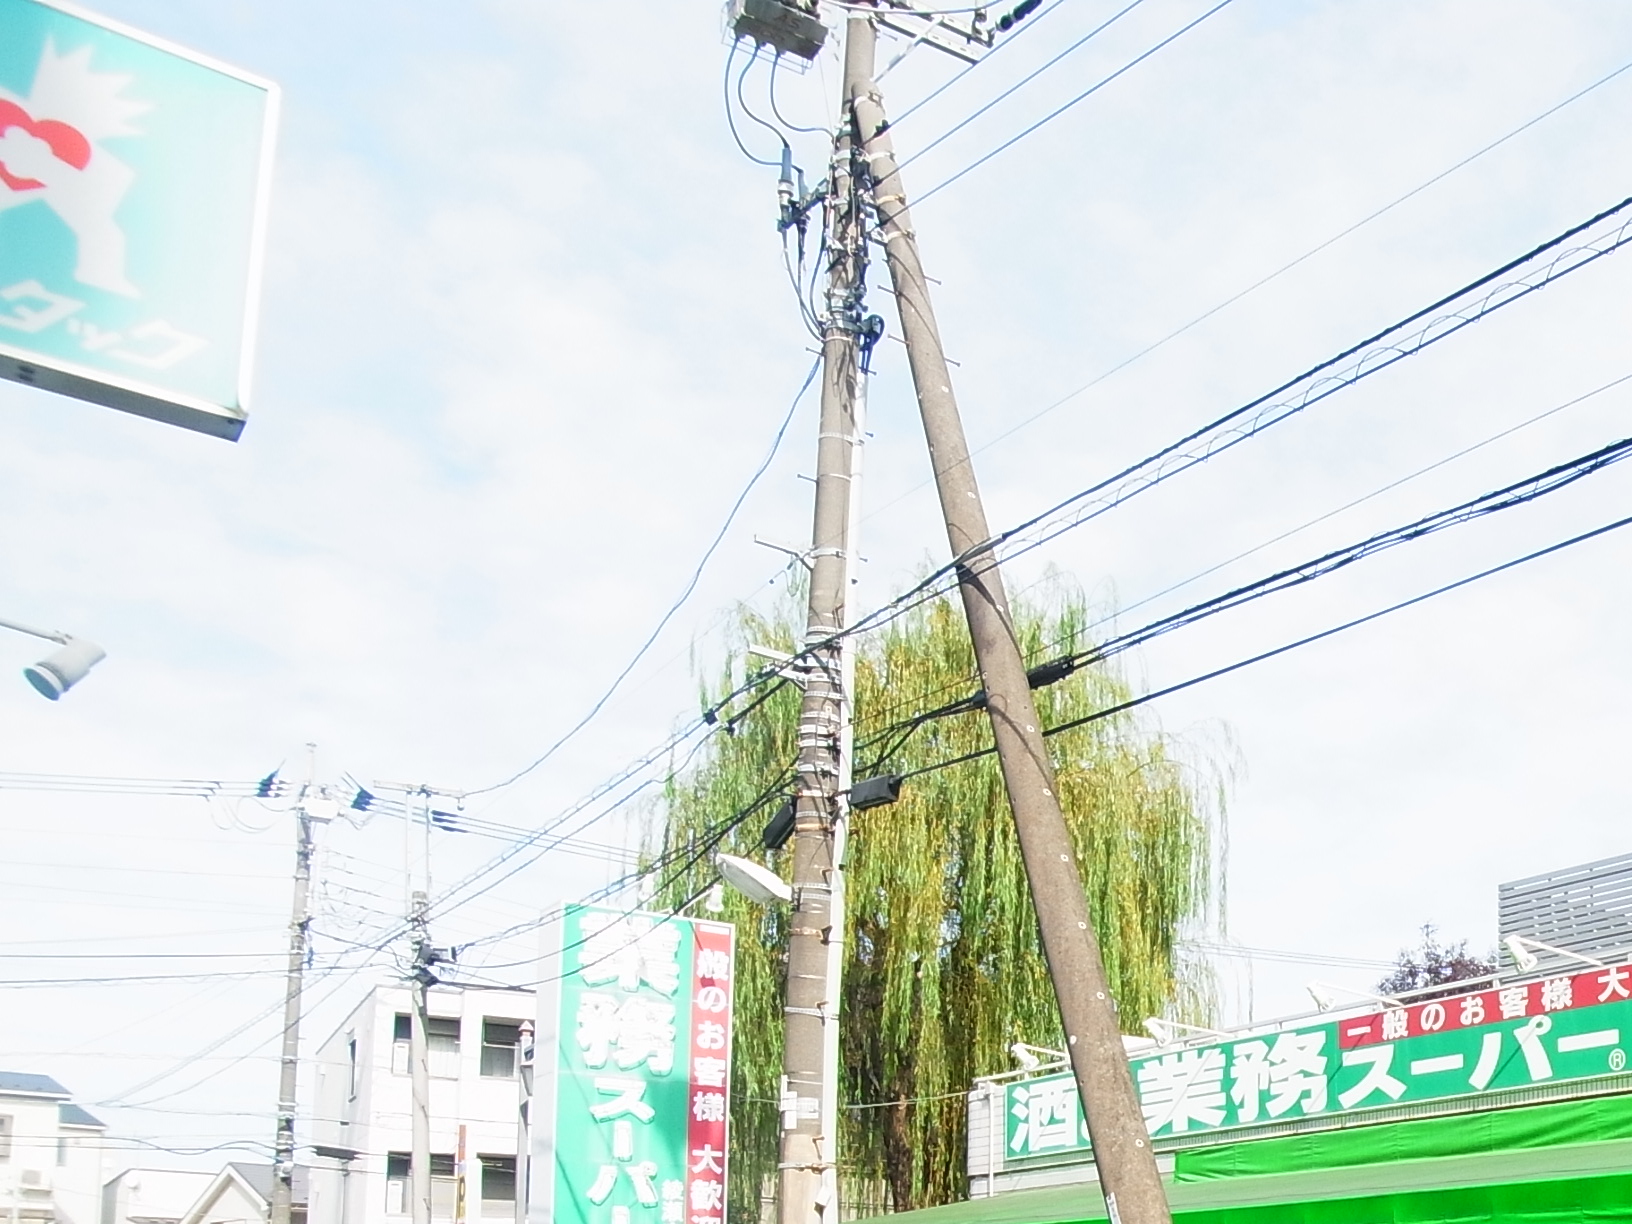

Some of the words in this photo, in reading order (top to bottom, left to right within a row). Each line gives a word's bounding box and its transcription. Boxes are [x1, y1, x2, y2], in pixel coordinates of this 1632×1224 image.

[693, 925, 731, 1123] 一般のお客様
[1346, 980, 1573, 1041] 一般のお客様
